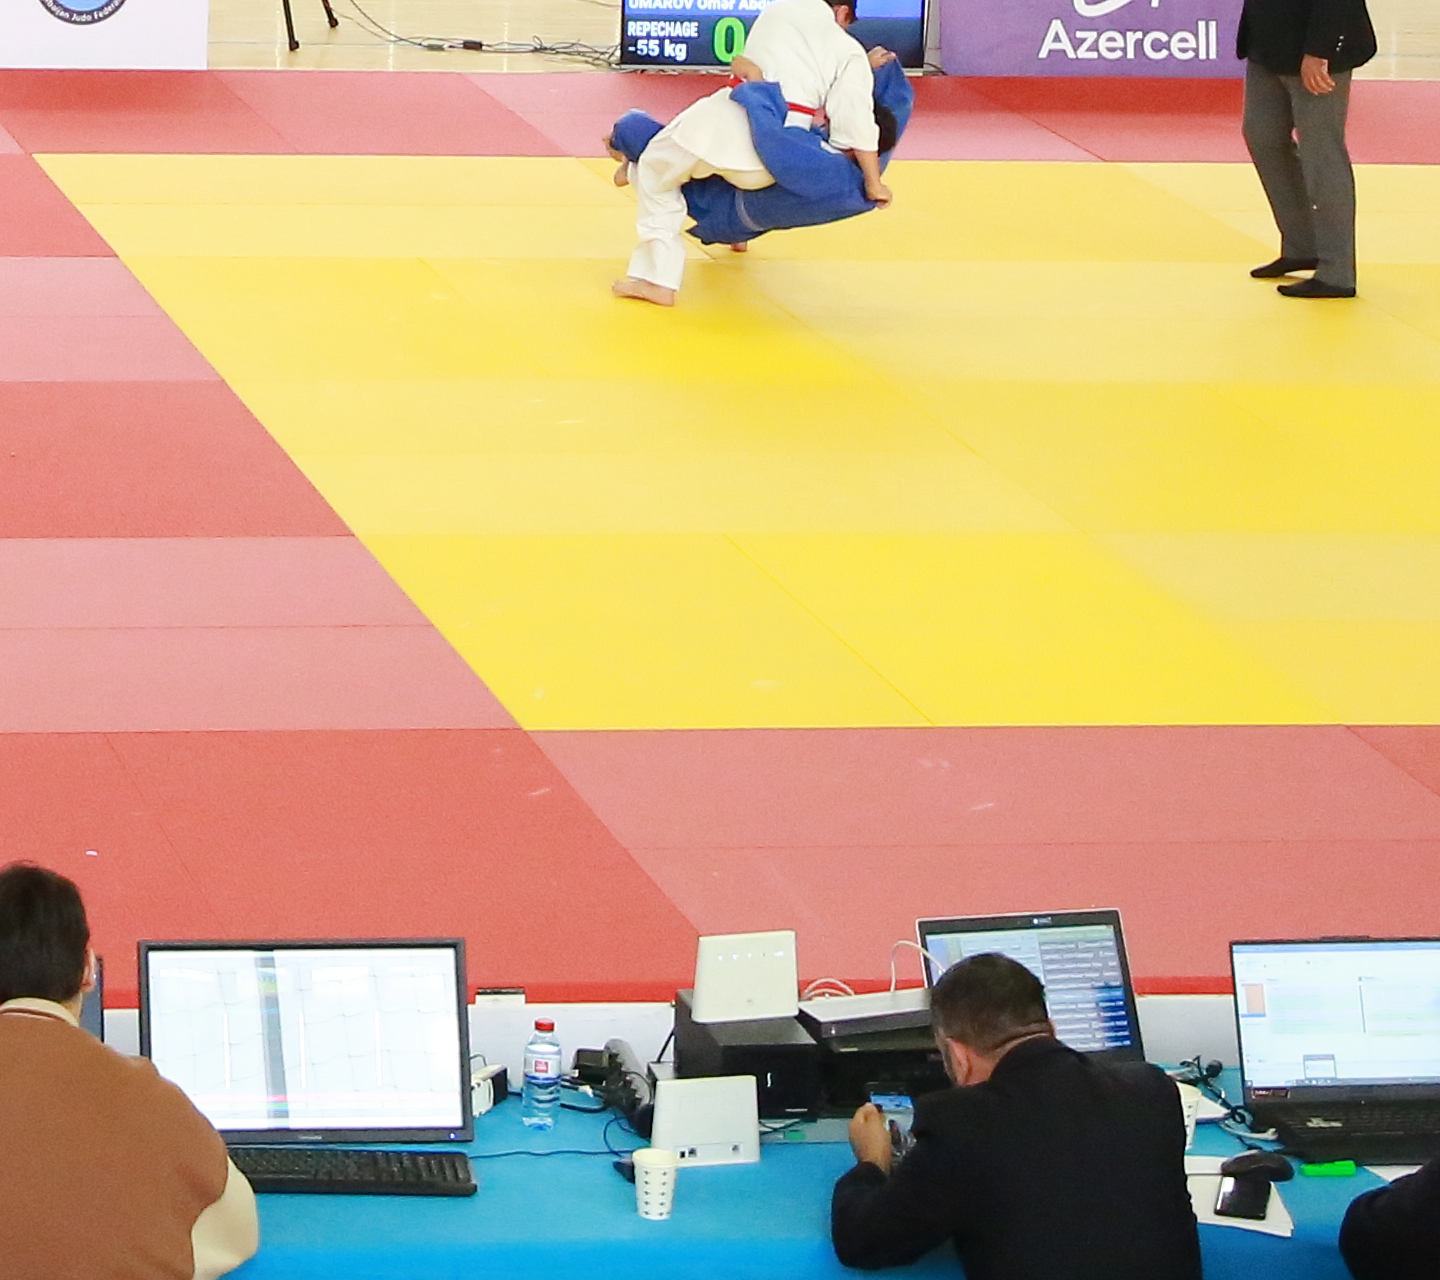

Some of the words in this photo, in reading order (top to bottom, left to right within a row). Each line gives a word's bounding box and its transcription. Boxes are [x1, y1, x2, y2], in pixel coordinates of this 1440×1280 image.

[627, 21, 699, 37] REPECHAGE
[1037, 18, 1218, 60] Azercell
[628, 39, 660, 56] -55
[663, 39, 688, 61] kg
